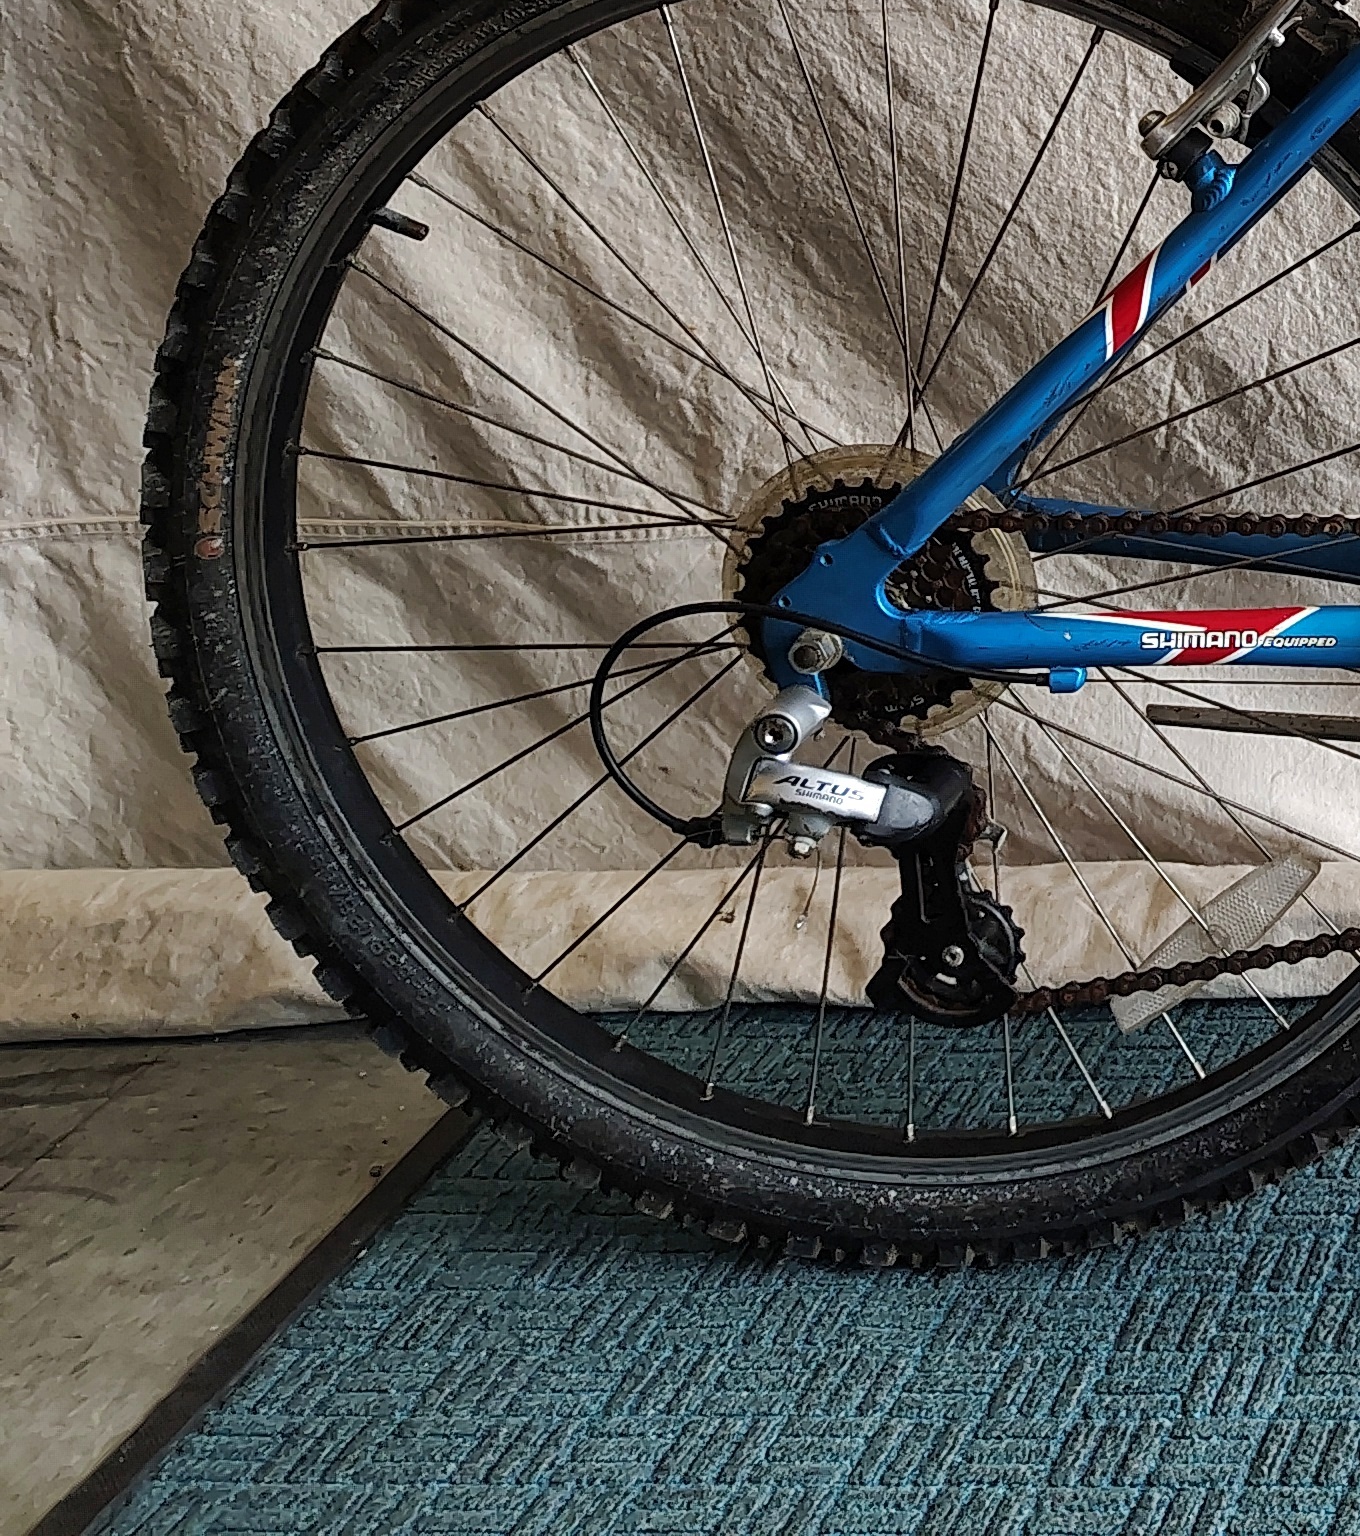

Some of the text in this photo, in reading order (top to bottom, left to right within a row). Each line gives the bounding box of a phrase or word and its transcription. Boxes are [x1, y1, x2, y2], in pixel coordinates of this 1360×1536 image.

[1141, 630, 1337, 649] SHIMANO EQUIPPED
[775, 776, 864, 802] ALTUS
[795, 789, 843, 805] SHIMANO
